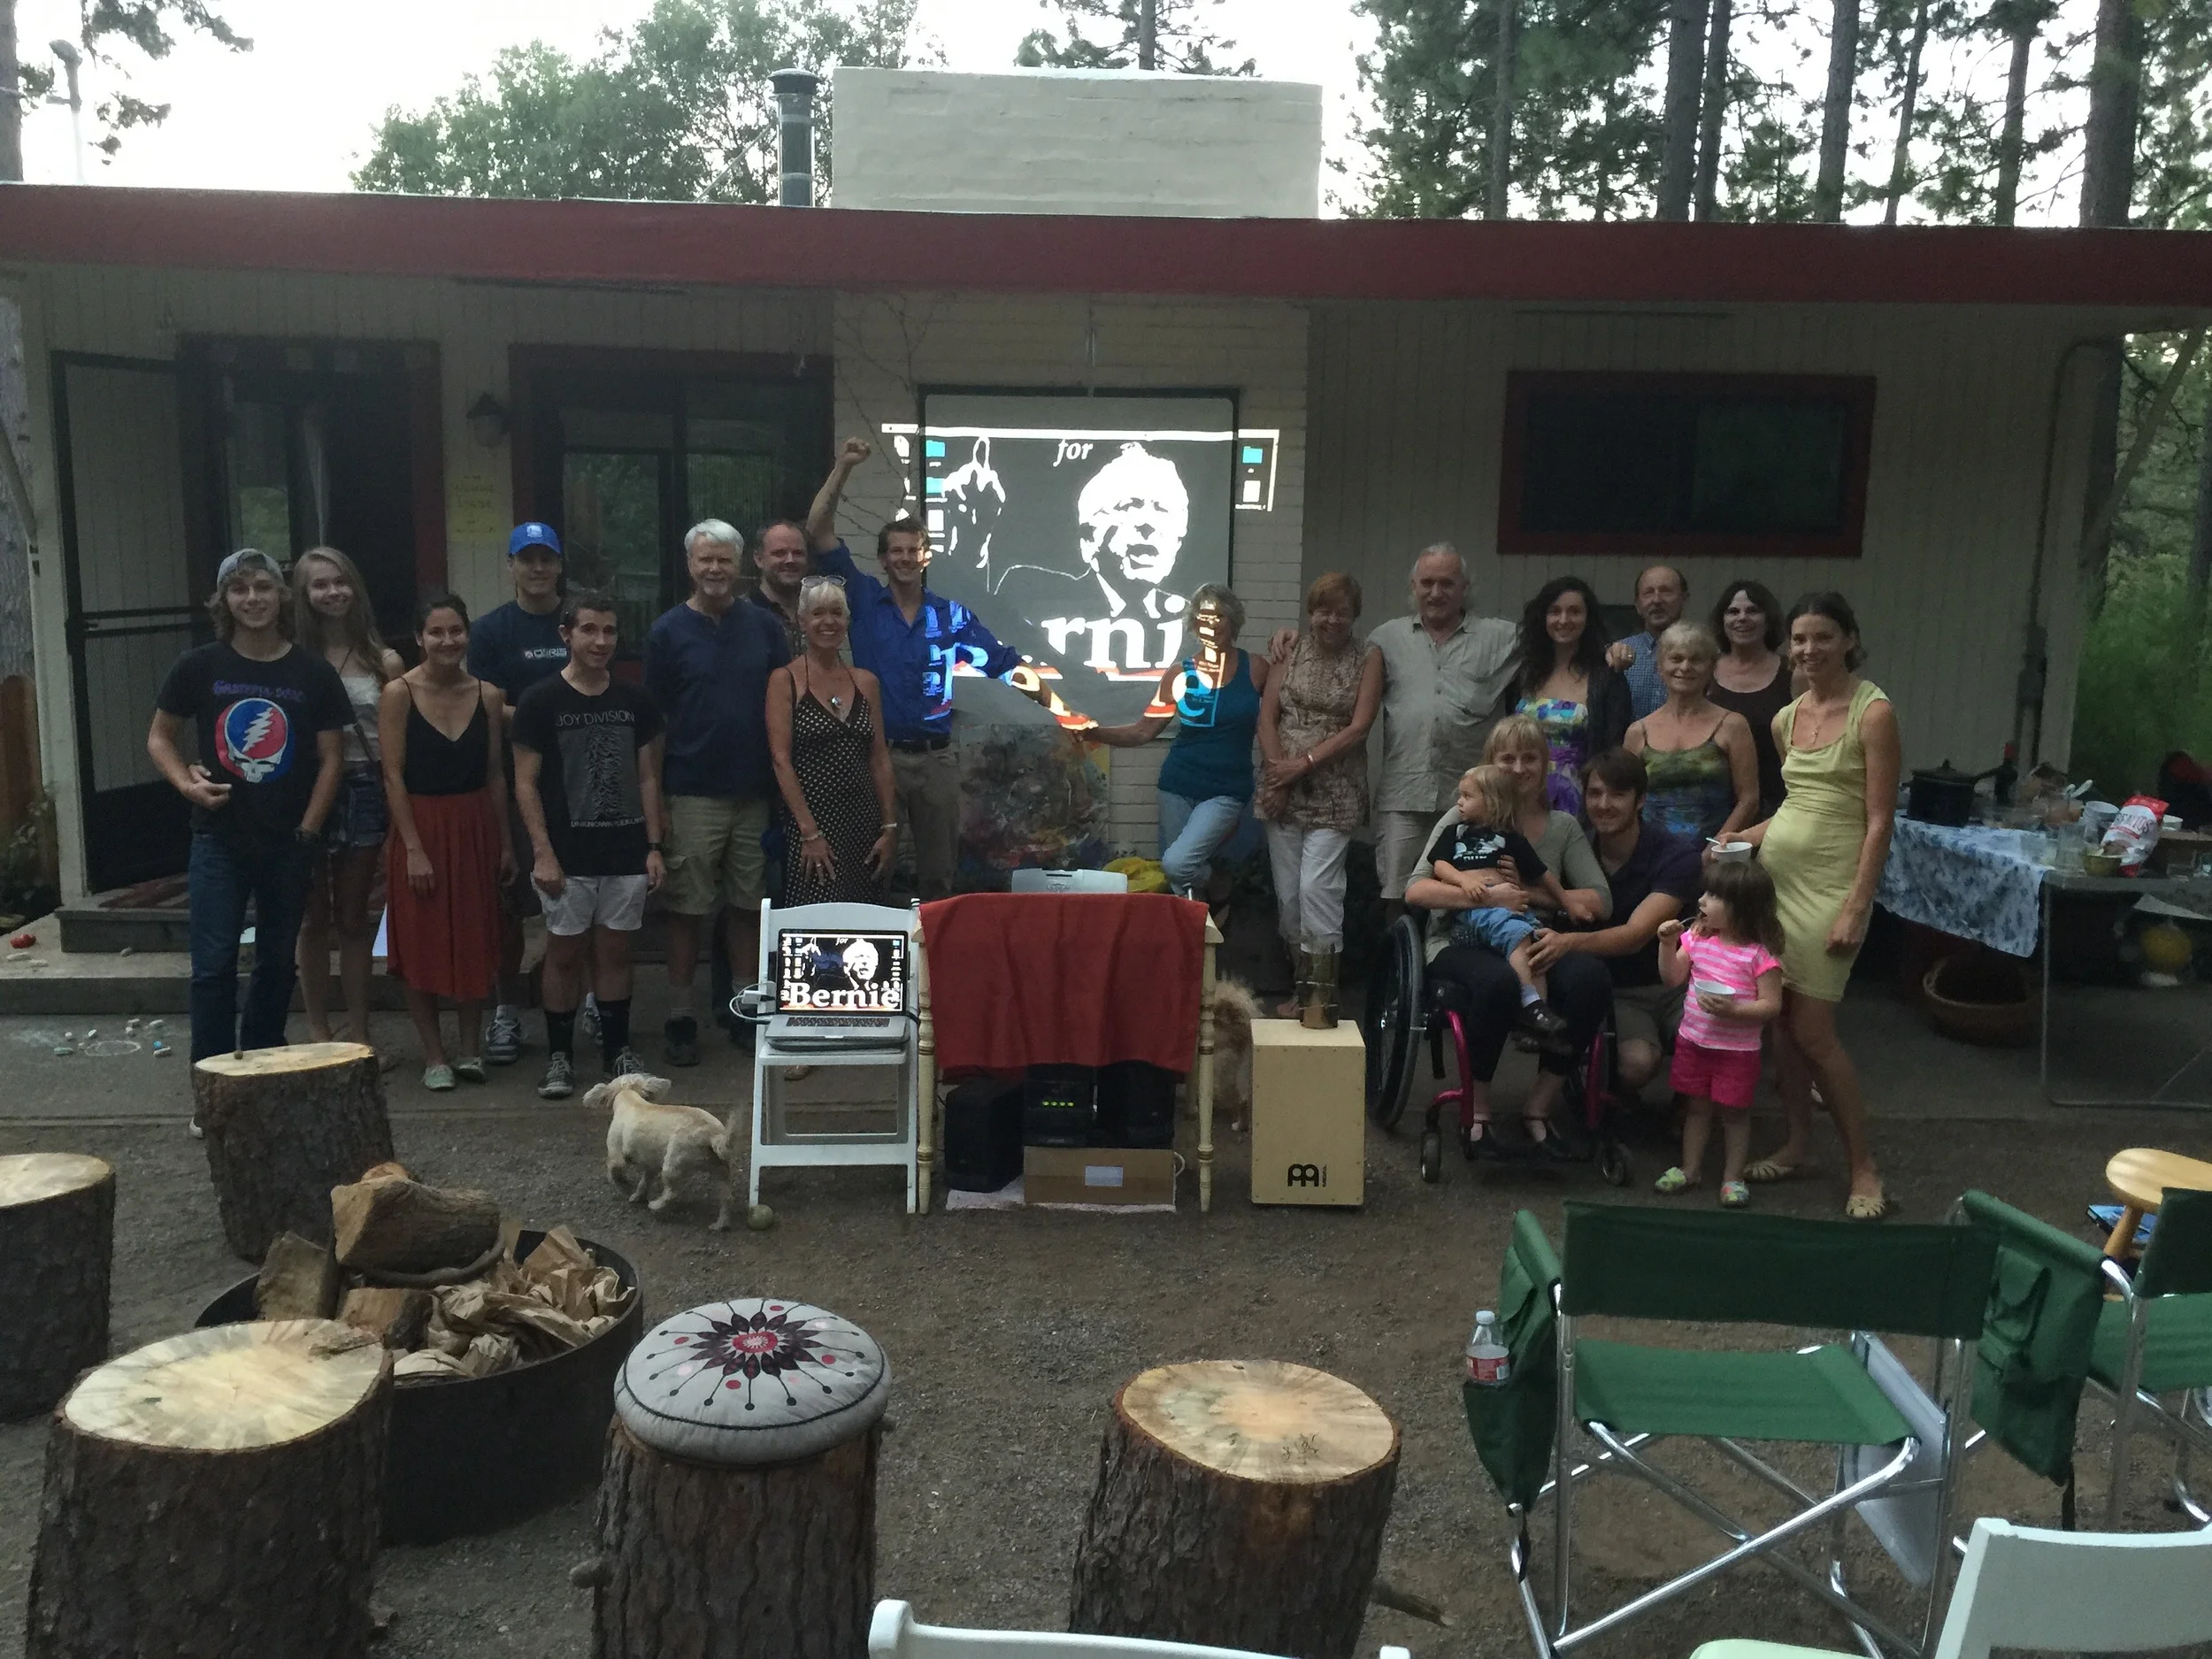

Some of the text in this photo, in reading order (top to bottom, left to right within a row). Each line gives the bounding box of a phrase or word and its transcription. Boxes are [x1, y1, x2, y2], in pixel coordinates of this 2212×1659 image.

[1053, 439, 1094, 466] for
[556, 710, 635, 726] JOY DIVISION
[835, 937, 849, 946] for
[789, 982, 900, 1008] Bernie
